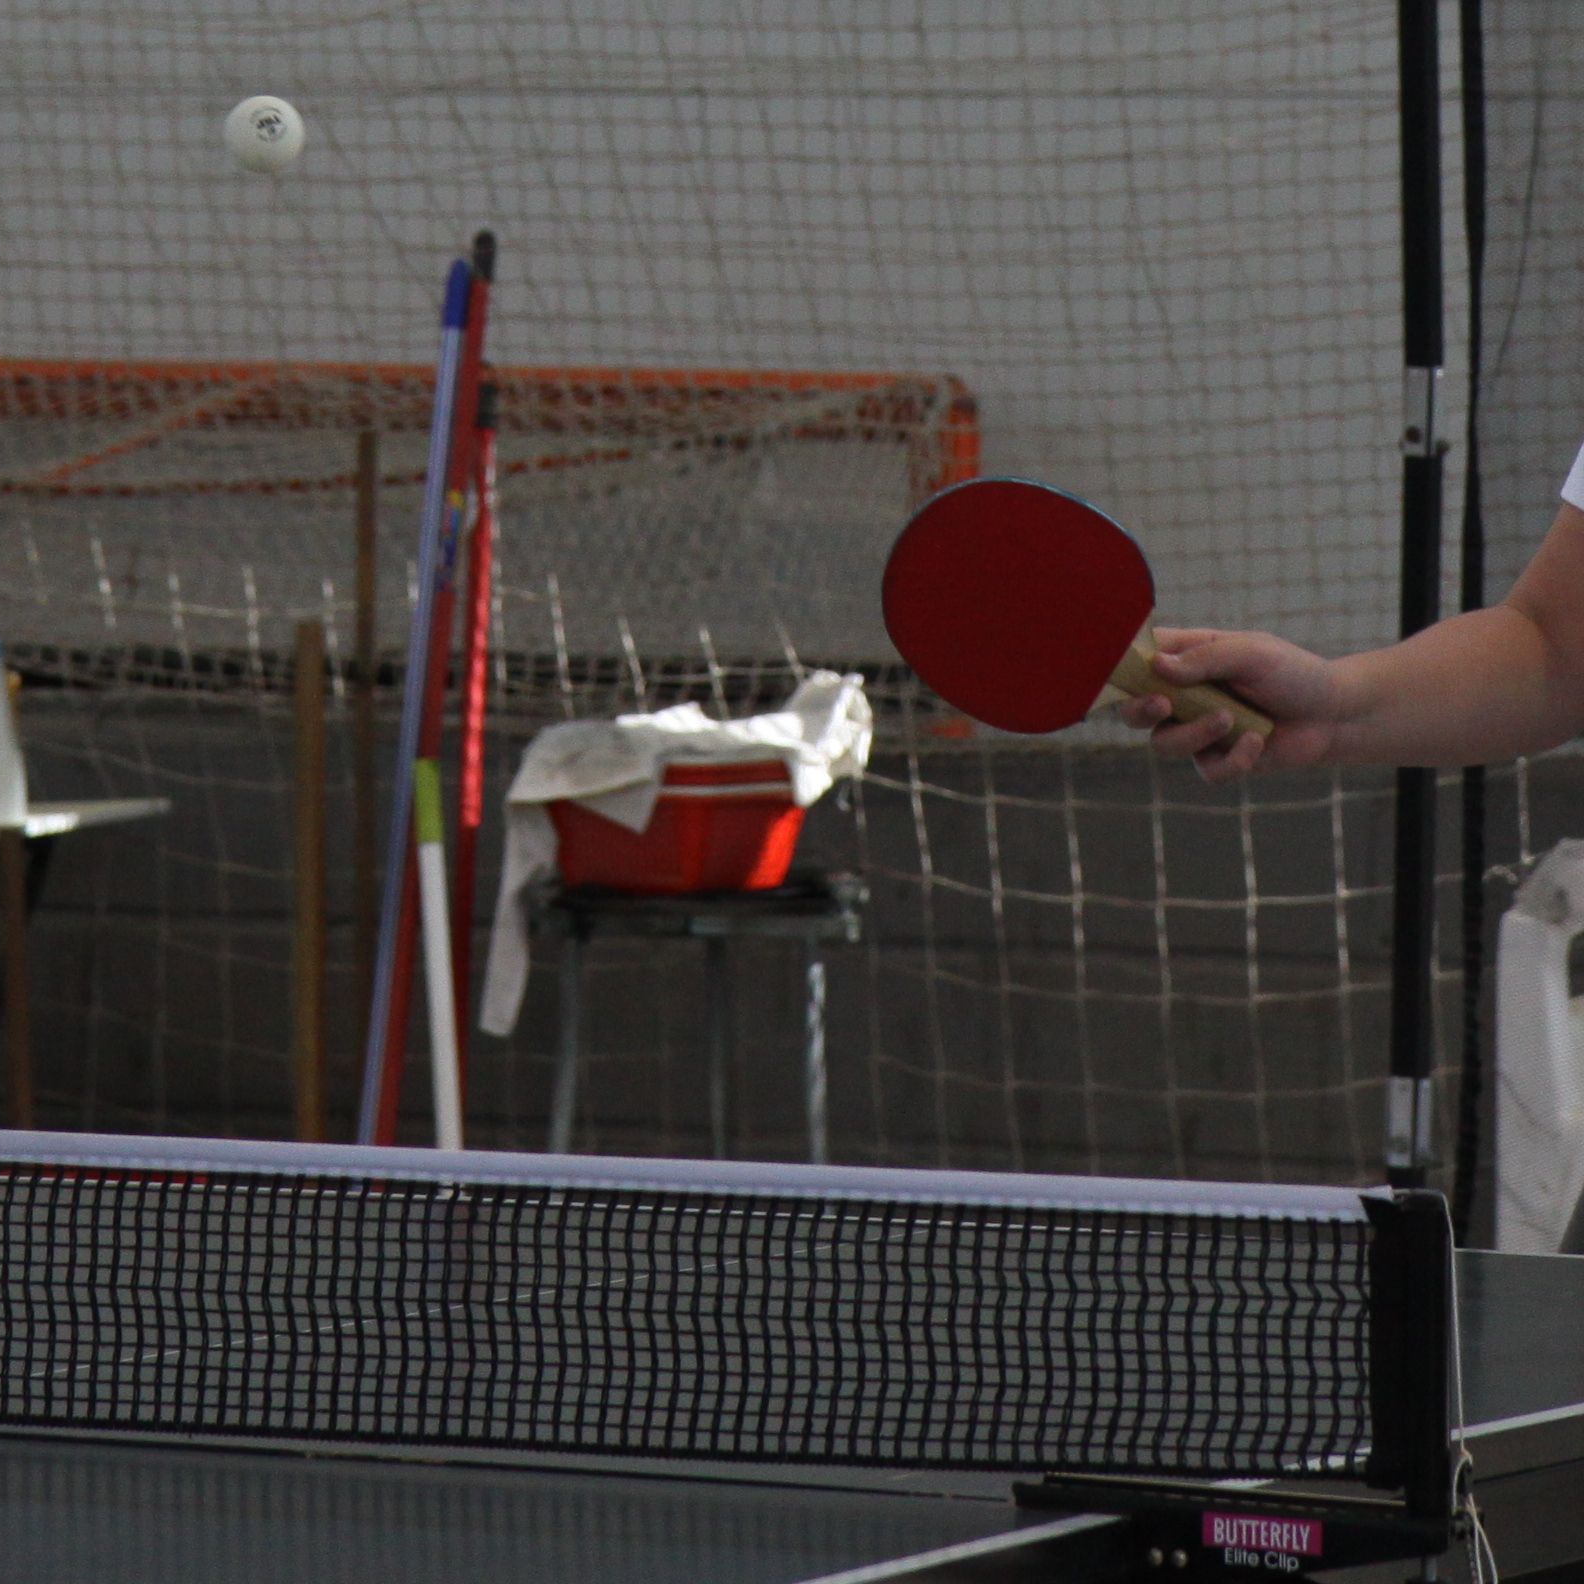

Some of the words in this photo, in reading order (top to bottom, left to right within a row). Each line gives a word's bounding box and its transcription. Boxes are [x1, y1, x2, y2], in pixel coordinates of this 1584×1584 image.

[1213, 1516, 1311, 1552] BUTTERFLY
[1223, 1547, 1260, 1568] Elite
[1263, 1550, 1300, 1573] Clip
